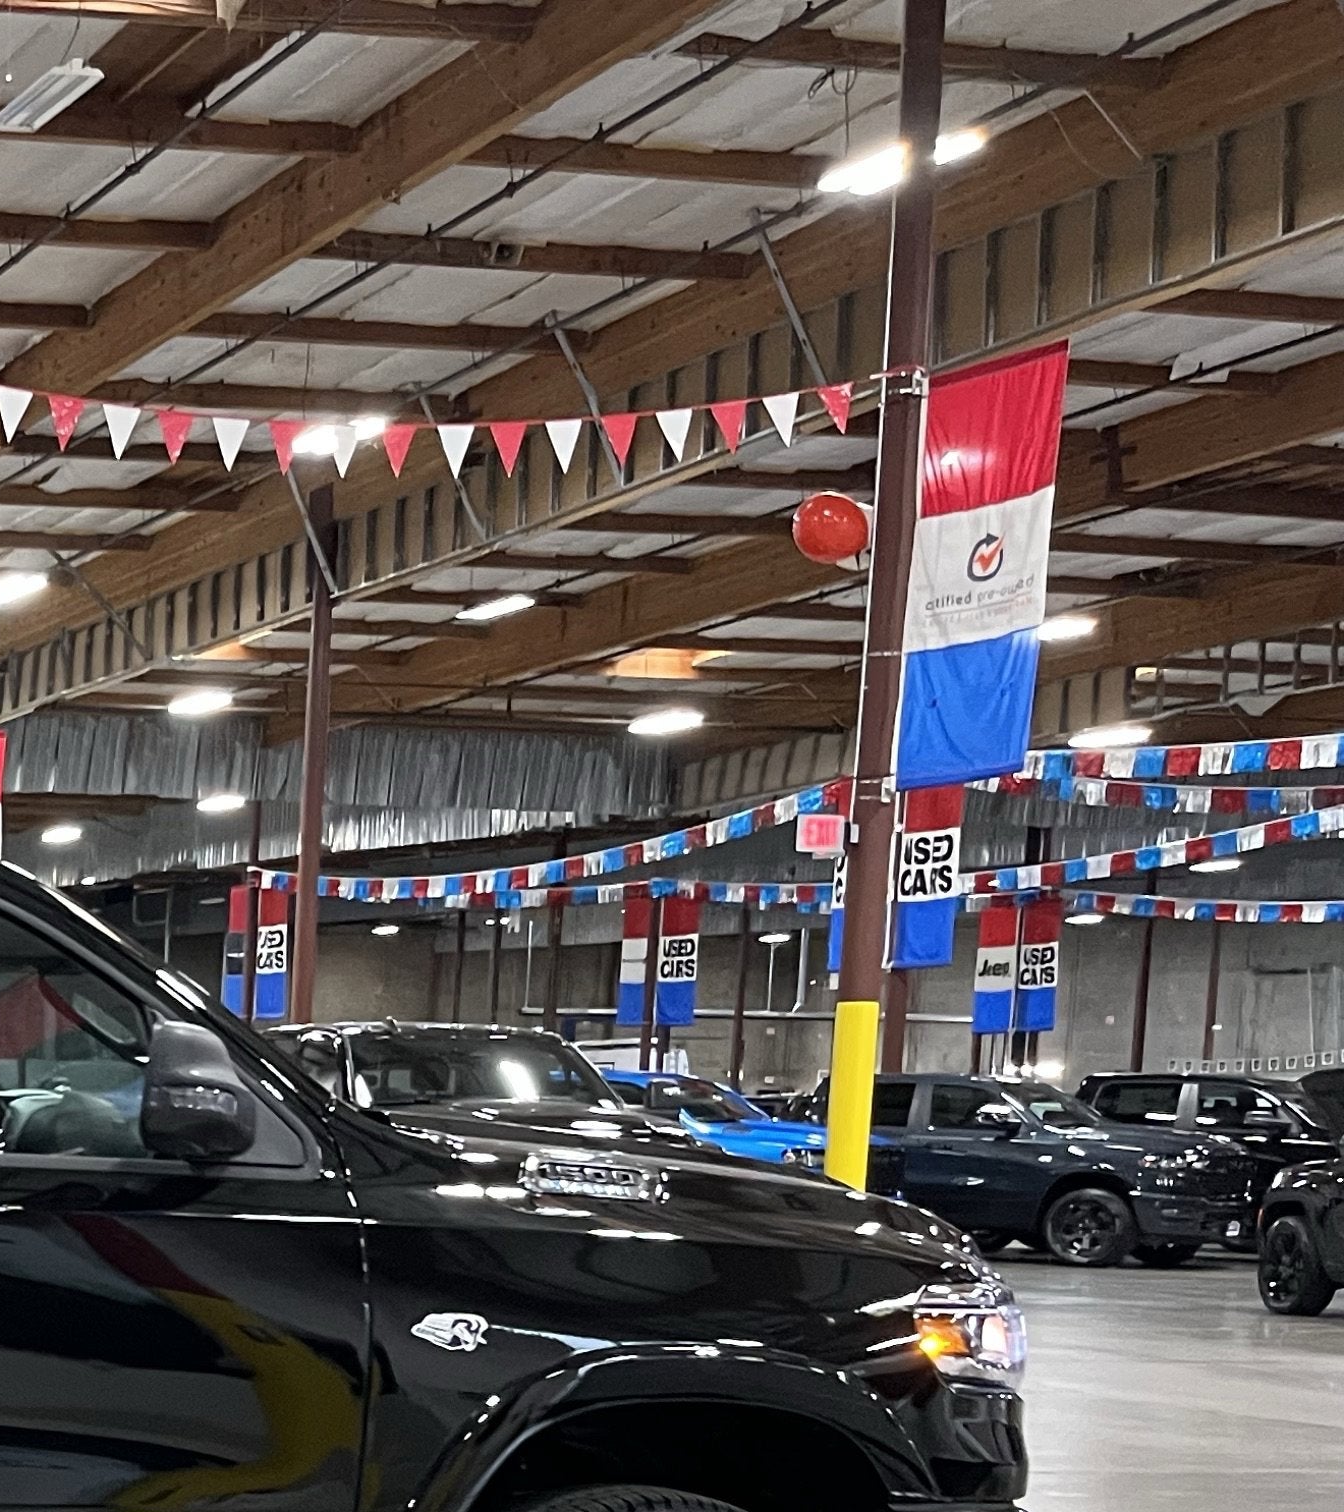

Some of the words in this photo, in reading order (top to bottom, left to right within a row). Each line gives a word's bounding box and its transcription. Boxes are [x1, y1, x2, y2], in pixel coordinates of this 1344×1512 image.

[904, 834, 954, 866] USED
[900, 865, 953, 896] CARS
[663, 938, 696, 958] USED
